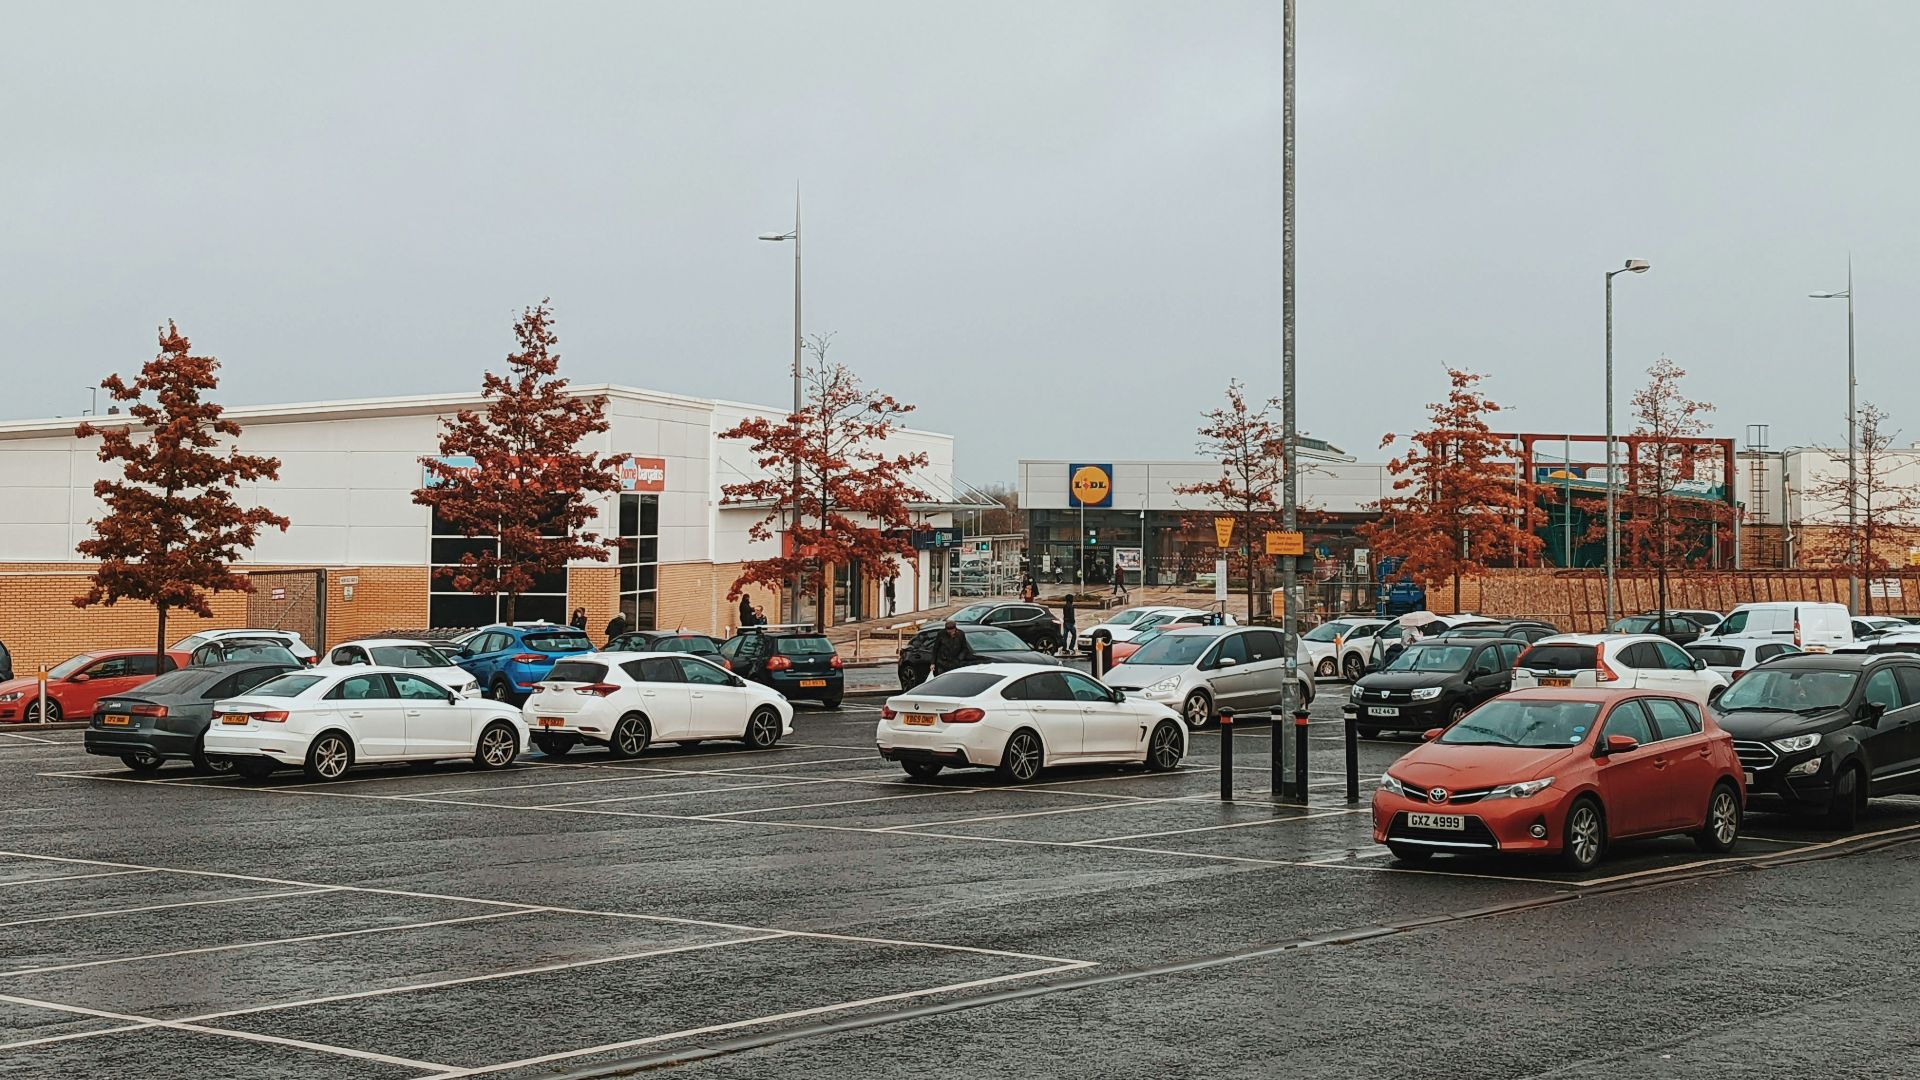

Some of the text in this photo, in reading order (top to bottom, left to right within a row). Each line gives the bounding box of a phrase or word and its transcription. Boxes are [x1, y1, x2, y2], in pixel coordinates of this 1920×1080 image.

[1074, 479, 1107, 489] LIDL
[1411, 815, 1460, 828] GXZ 4999
